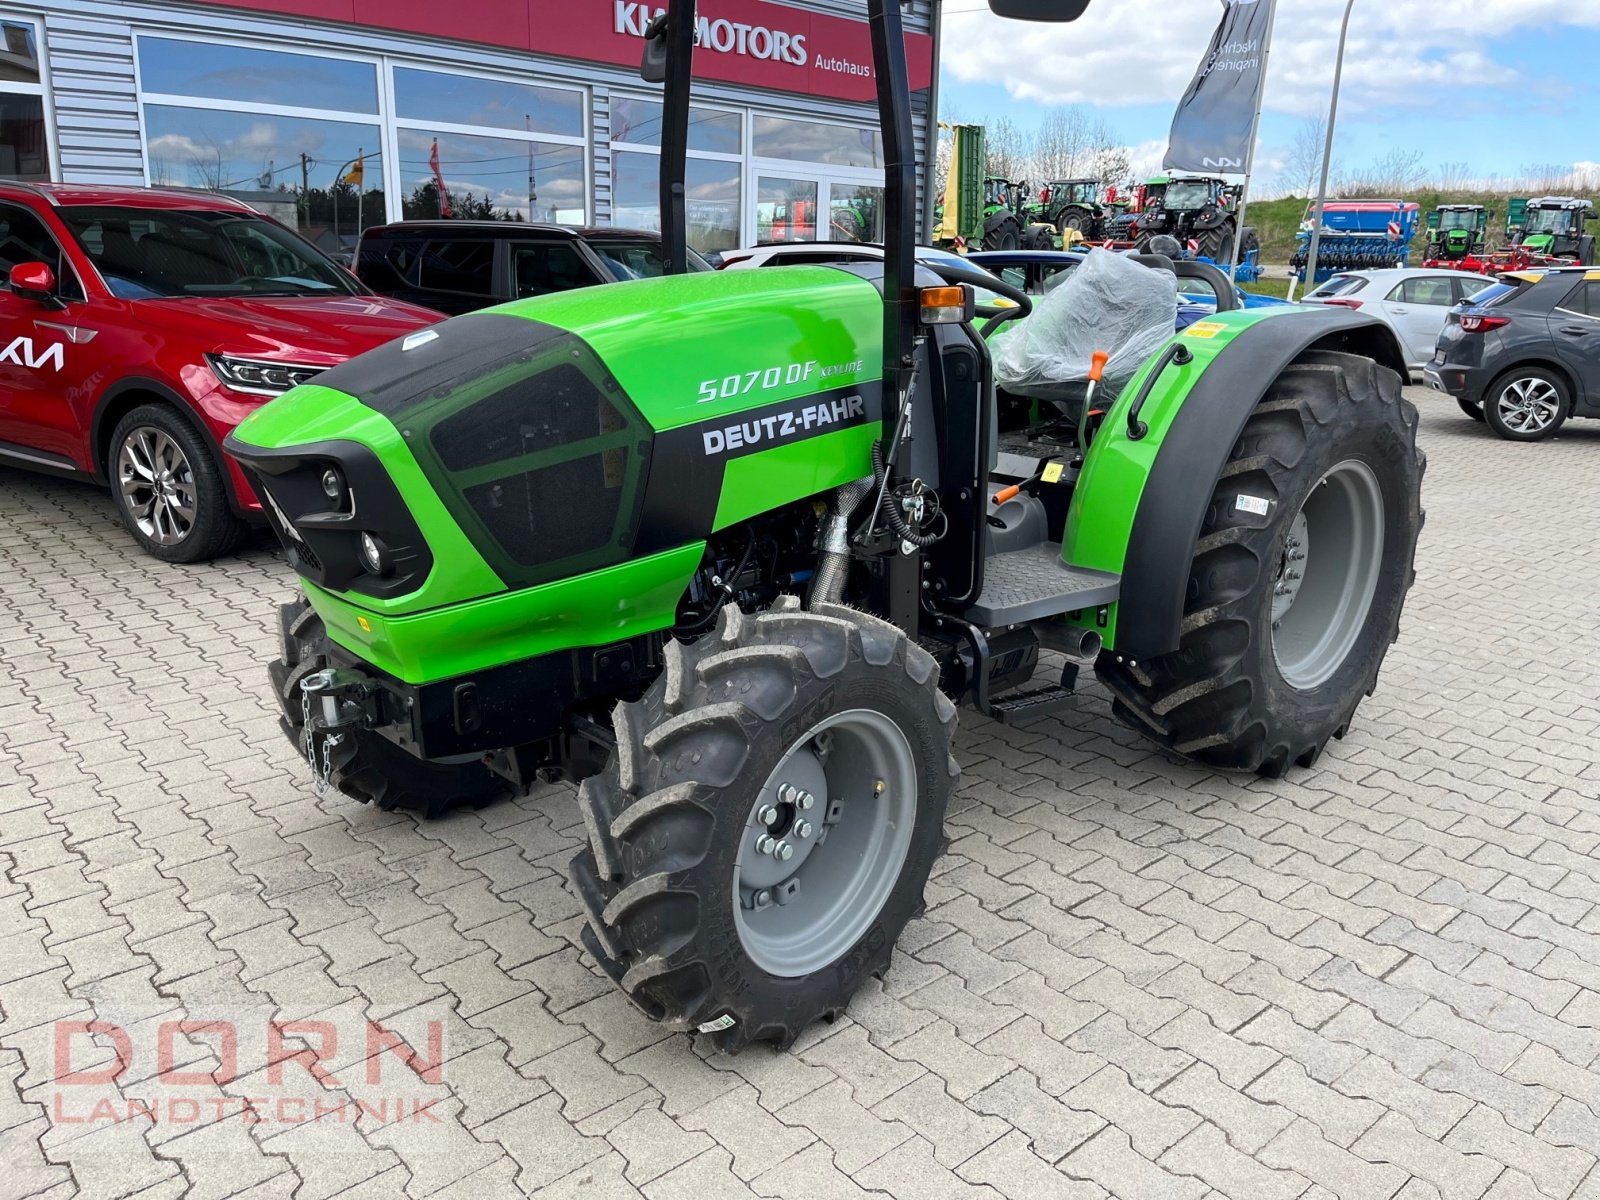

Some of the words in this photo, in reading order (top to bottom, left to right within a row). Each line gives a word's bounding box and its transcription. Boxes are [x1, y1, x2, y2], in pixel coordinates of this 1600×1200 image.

[613, 0, 667, 37] KI
[815, 54, 870, 77] Autohaus
[702, 395, 865, 456] DEUTZ-FAHR
